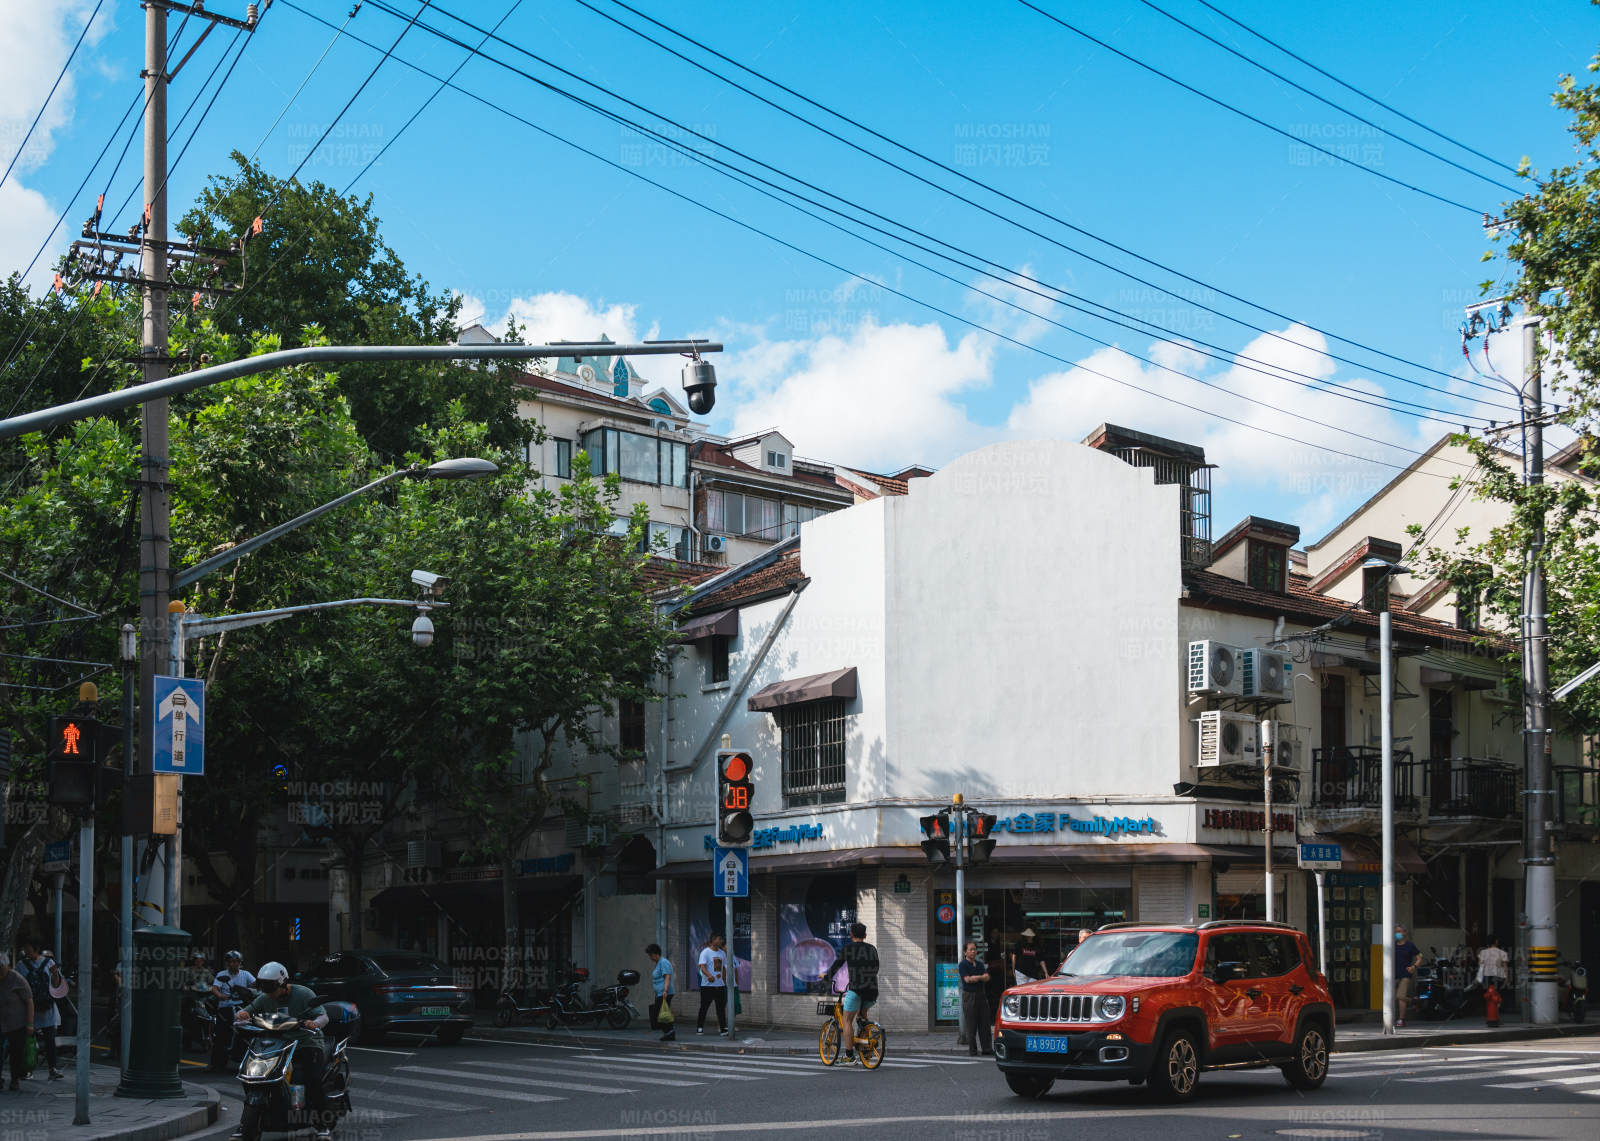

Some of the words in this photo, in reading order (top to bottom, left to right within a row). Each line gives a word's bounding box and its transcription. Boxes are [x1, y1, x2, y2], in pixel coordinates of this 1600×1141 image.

[174, 710, 184, 762] 单行道
[725, 786, 748, 809] 08
[1013, 812, 1056, 834] 全家
[1059, 813, 1155, 838] FamilyMart
[727, 870, 736, 892] 单行道
